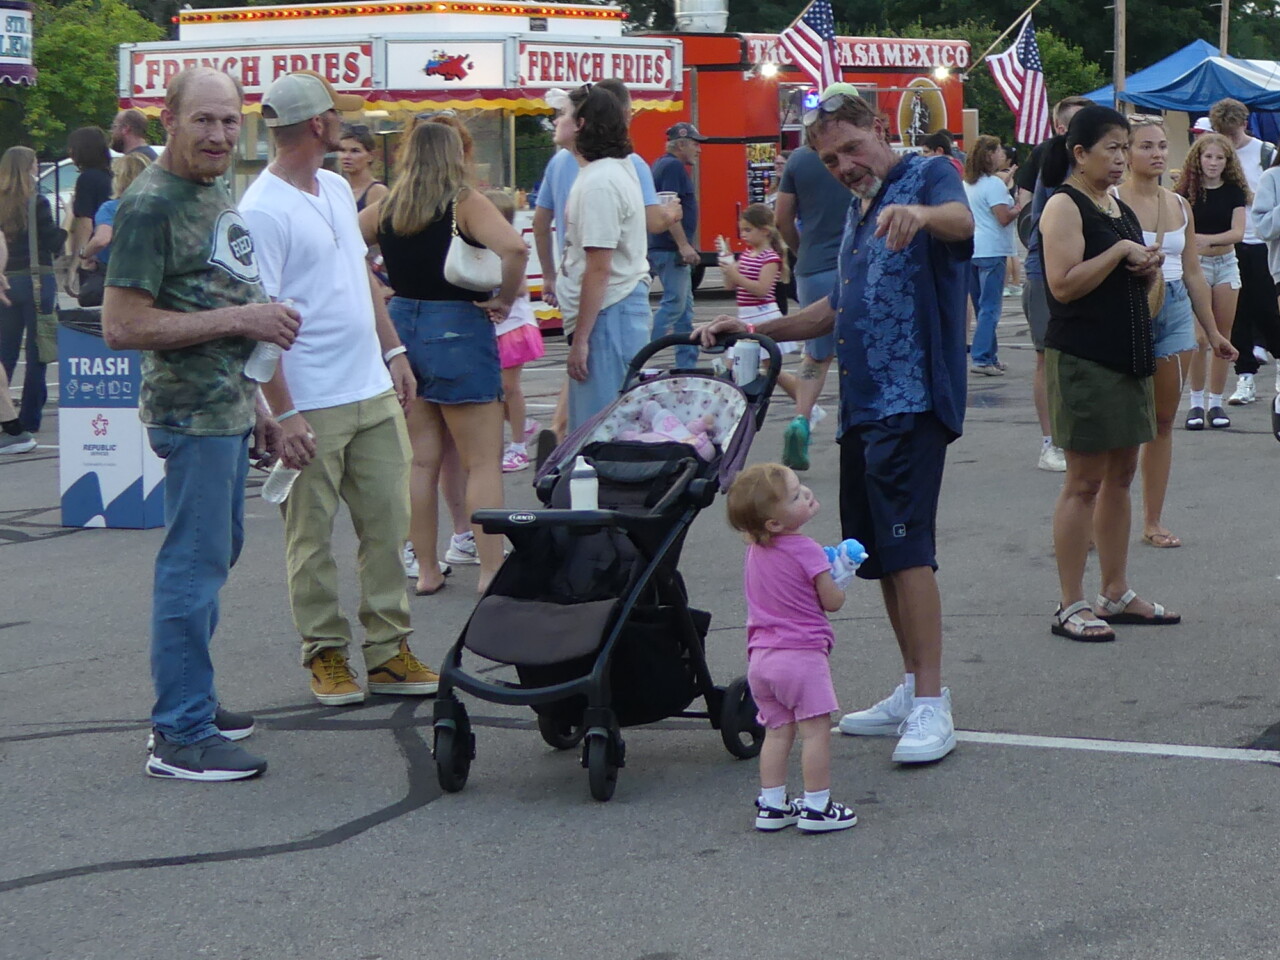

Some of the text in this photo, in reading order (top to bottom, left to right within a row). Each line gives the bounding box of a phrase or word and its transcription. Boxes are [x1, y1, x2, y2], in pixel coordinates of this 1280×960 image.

[750, 39, 793, 65] TAC
[272, 52, 361, 83] FRIES
[528, 51, 666, 84] FRENCH FRIES
[68, 358, 130, 376] TRASH
